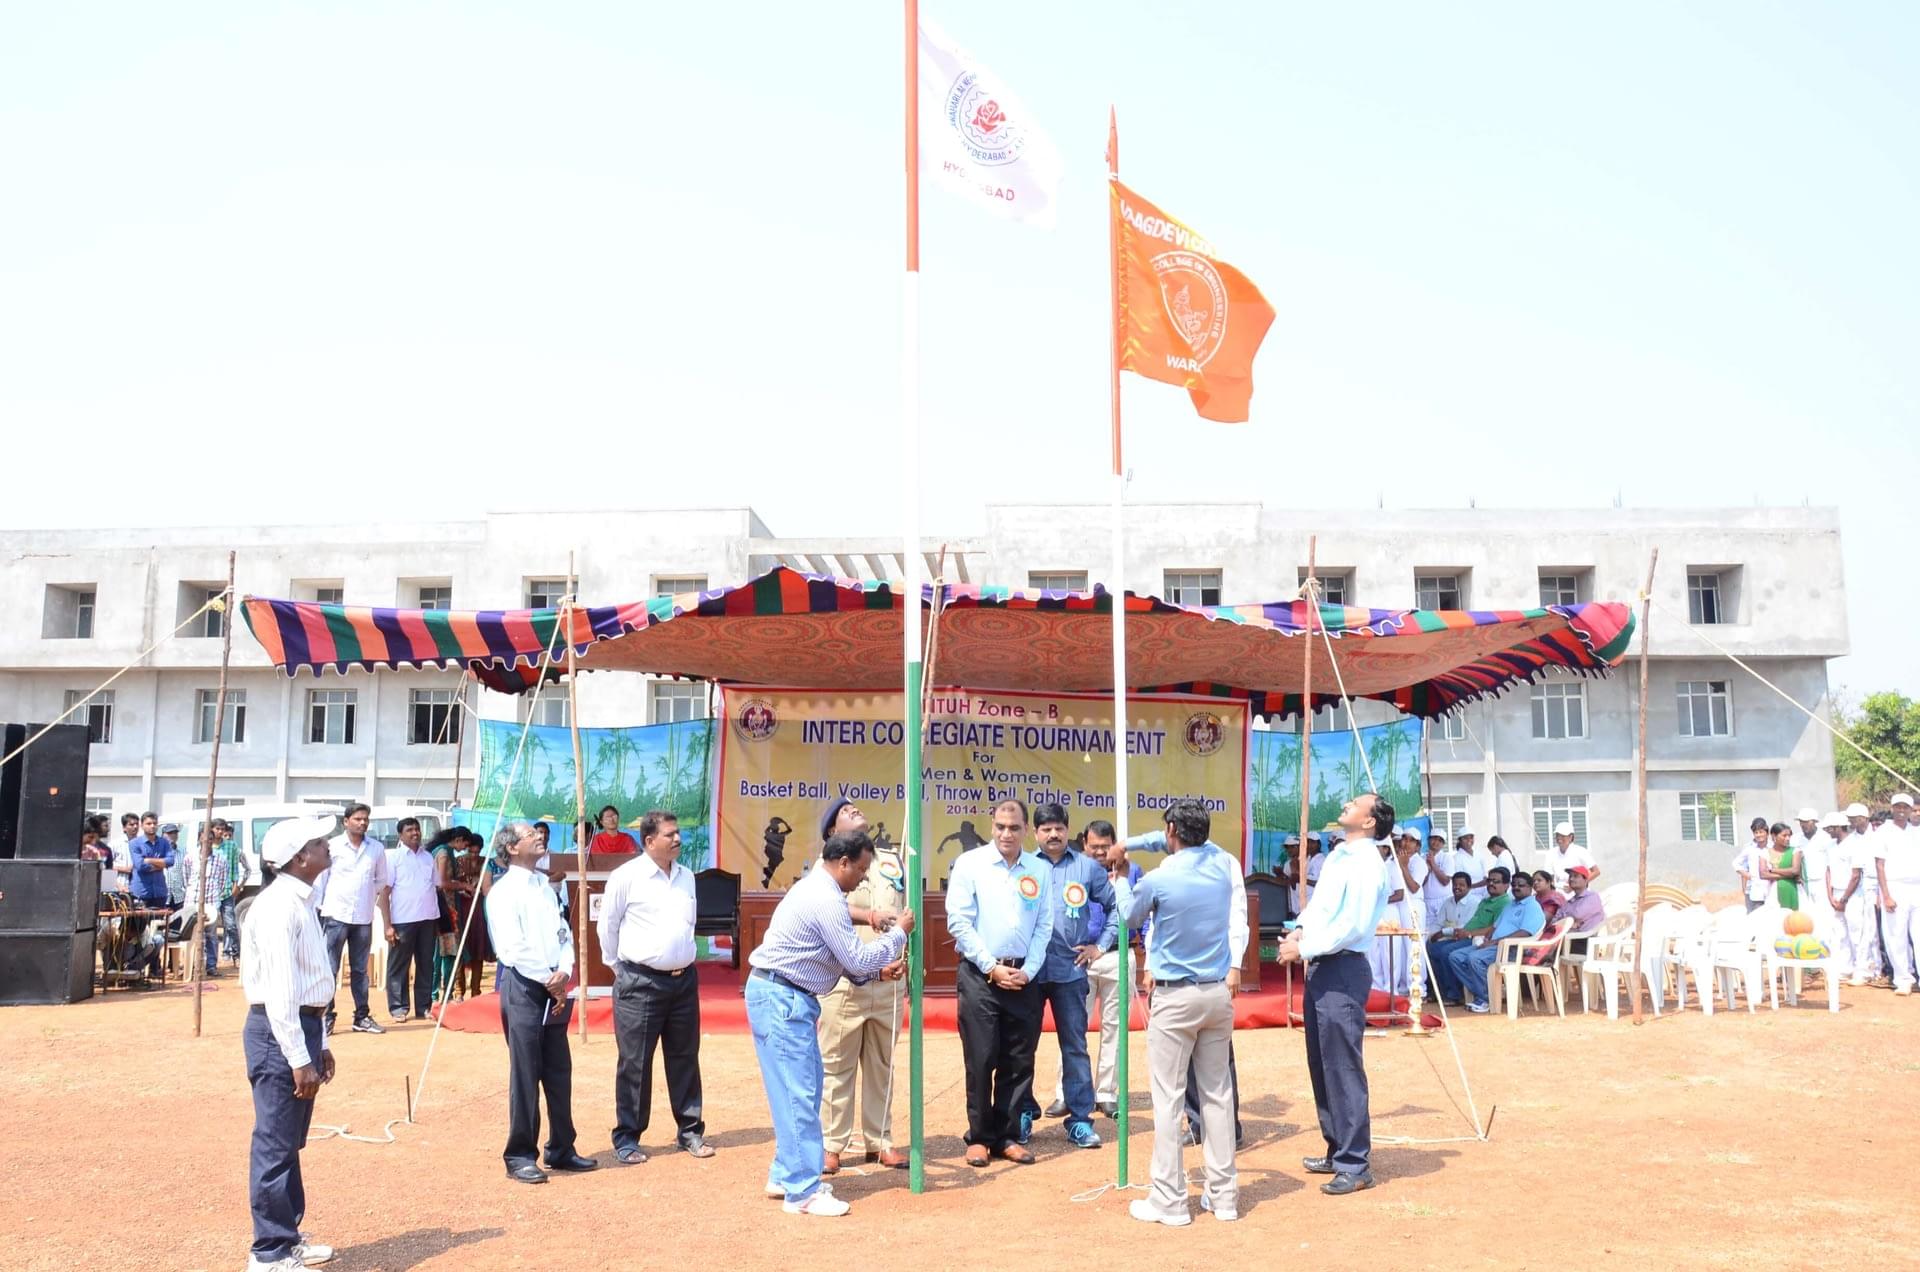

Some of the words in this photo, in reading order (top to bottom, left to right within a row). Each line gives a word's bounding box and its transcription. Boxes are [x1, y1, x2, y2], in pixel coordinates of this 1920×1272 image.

[978, 701, 1025, 718] Zone
[1048, 703, 1059, 719] B
[802, 720, 866, 744] INTER
[873, 721, 1004, 748] COEGIATE
[972, 751, 994, 764] For
[963, 768, 974, 781] &
[981, 768, 1051, 785] Women
[740, 780, 792, 797] Basket
[798, 781, 831, 800] Ball,
[838, 782, 891, 803] Volley
[935, 784, 982, 801] Throw
[1026, 787, 1071, 806] Table
[946, 804, 977, 815] 2014
